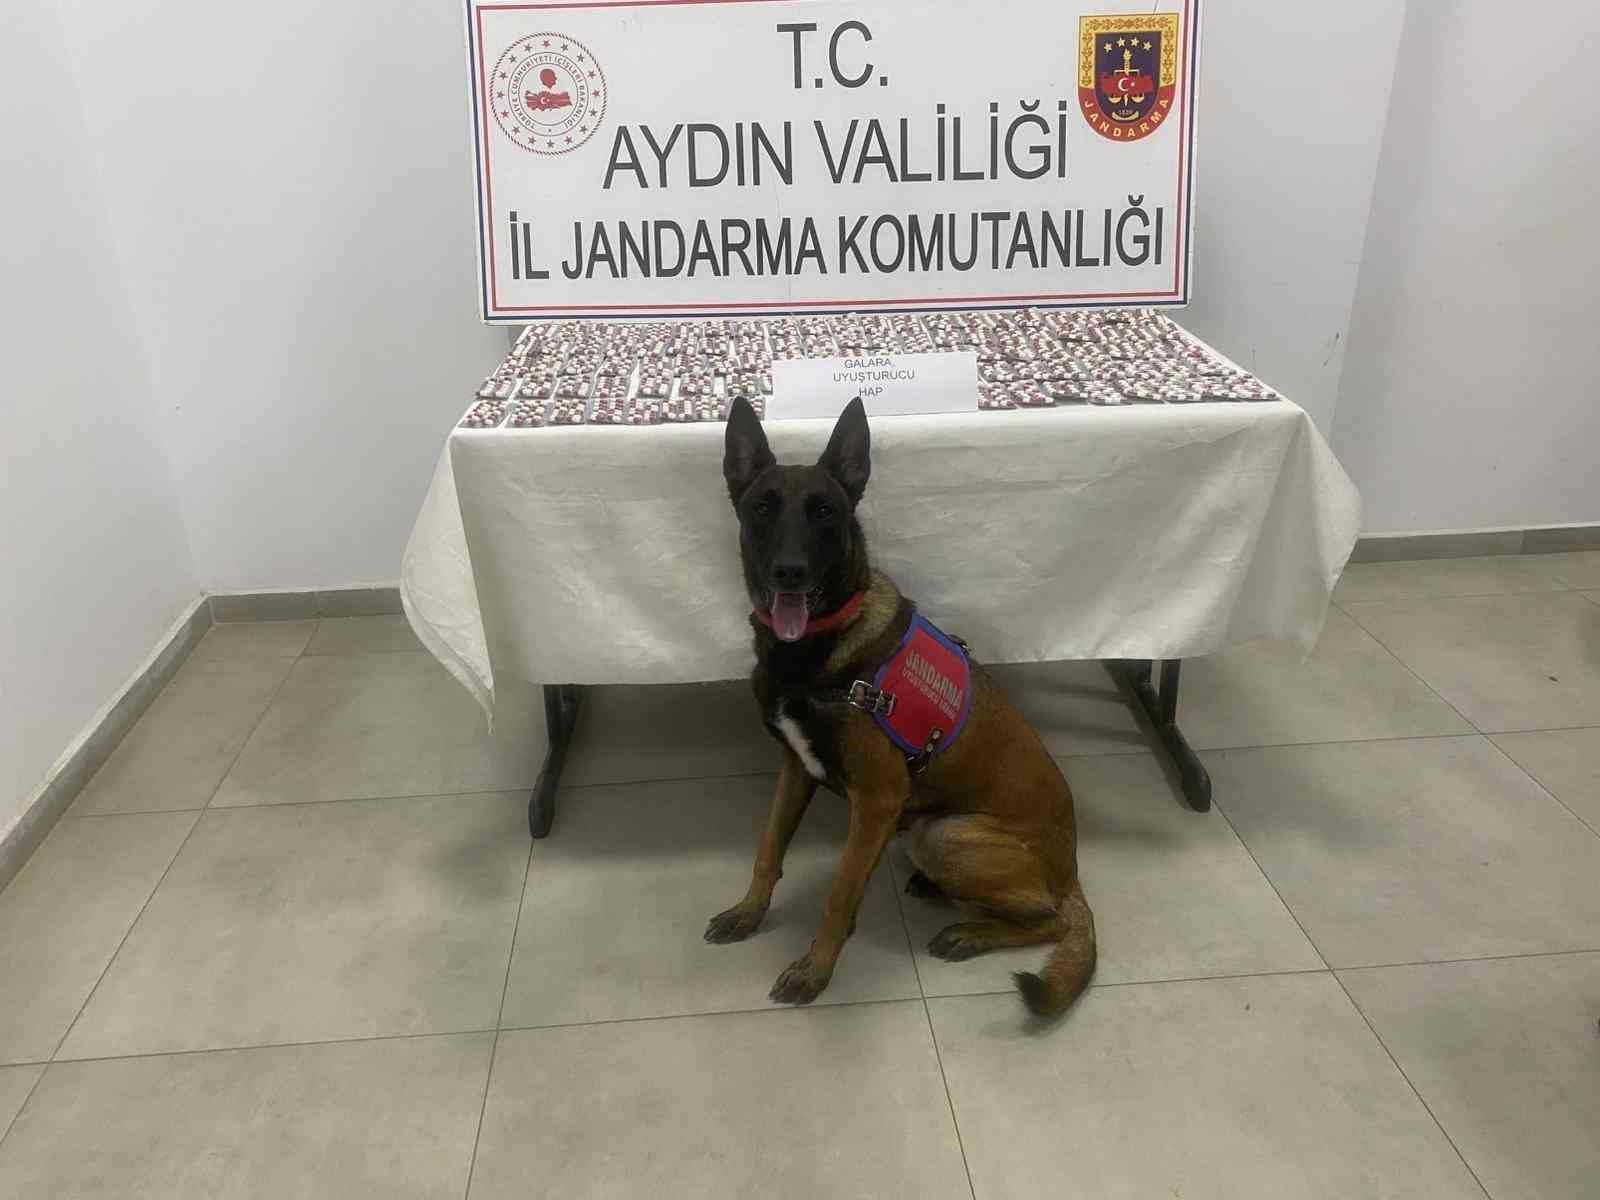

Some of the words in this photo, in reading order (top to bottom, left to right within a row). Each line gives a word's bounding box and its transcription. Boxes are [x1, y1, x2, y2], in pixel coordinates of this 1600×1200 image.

[777, 20, 888, 89] T.C.
[602, 121, 793, 189] AYDIN
[813, 100, 1068, 184] VALİLİĞİ
[1084, 99, 1169, 138] JANDARMA
[509, 210, 550, 280] İL
[562, 217, 827, 279] JANDARMA
[838, 194, 1164, 274] KOMUTANLIĞI
[833, 369, 916, 383] UYUŞTURUCU
[859, 387, 883, 397] HAP
[905, 649, 963, 712] JANDARMA
